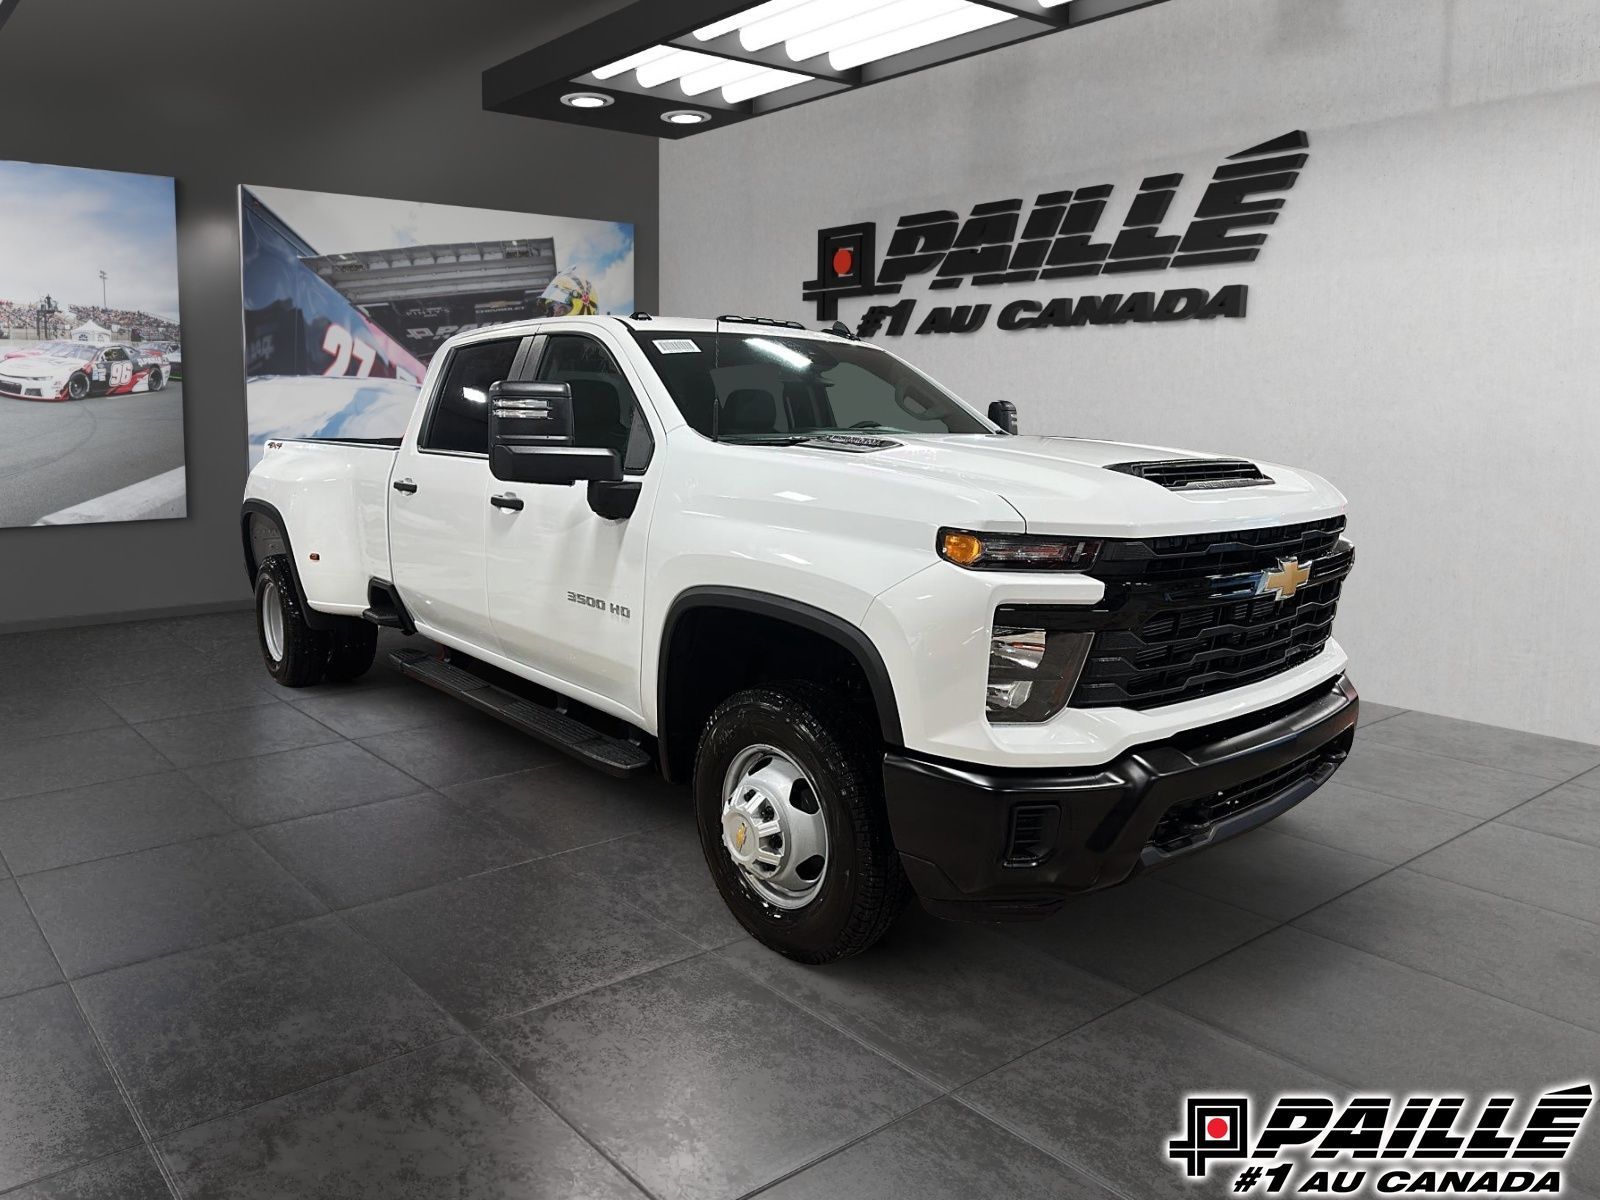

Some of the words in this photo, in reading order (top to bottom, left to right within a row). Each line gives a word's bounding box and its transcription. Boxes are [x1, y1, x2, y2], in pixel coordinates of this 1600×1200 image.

[876, 129, 1309, 290] PAILLÉ
[856, 299, 917, 337] #1
[914, 304, 992, 335] AU
[997, 284, 1249, 331] CANADA
[108, 360, 134, 387] 96
[567, 591, 606, 611] 3500
[609, 602, 631, 619] HD
